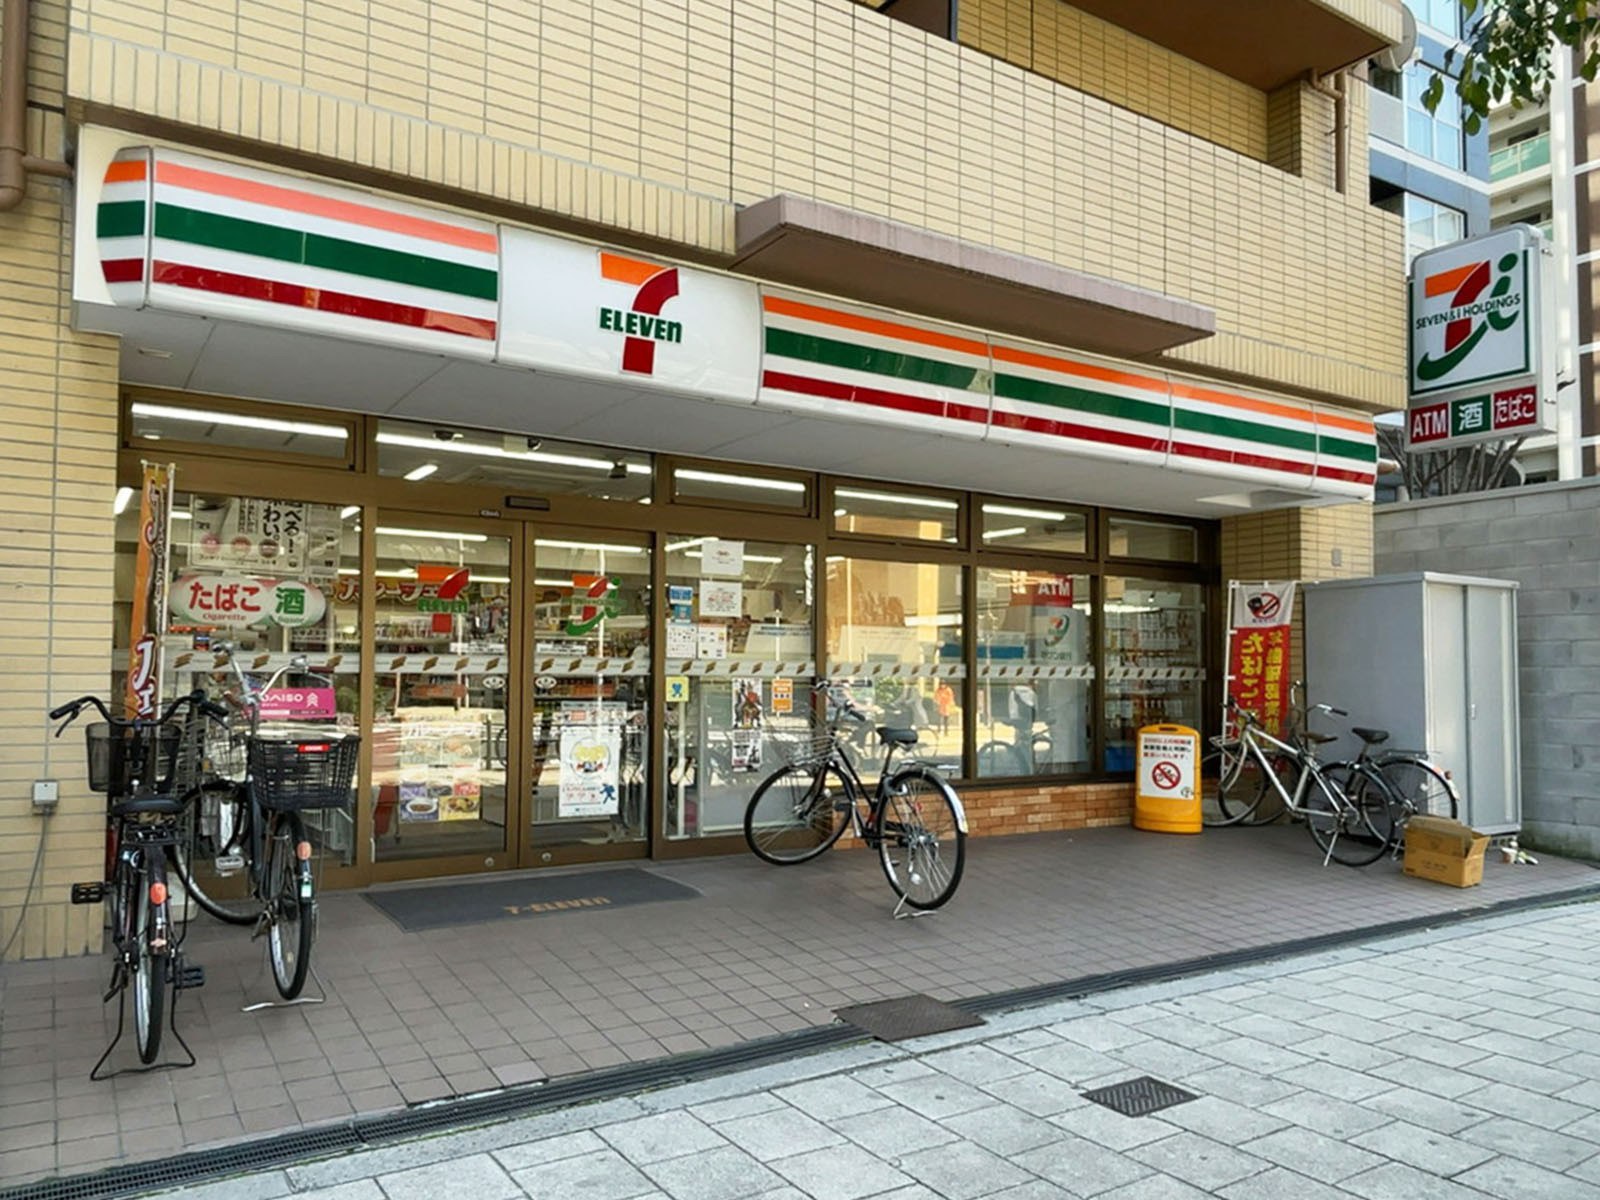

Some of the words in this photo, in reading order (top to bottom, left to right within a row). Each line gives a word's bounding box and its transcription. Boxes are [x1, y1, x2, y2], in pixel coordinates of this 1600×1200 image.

[1464, 293, 1521, 317] HOLDINGS
[1458, 402, 1484, 431] 酒
[1495, 393, 1535, 424] たばこ
[1412, 409, 1447, 438] ATM
[188, 581, 261, 612] たばこ
[275, 587, 306, 615] 酒
[1038, 580, 1070, 596] ATM
